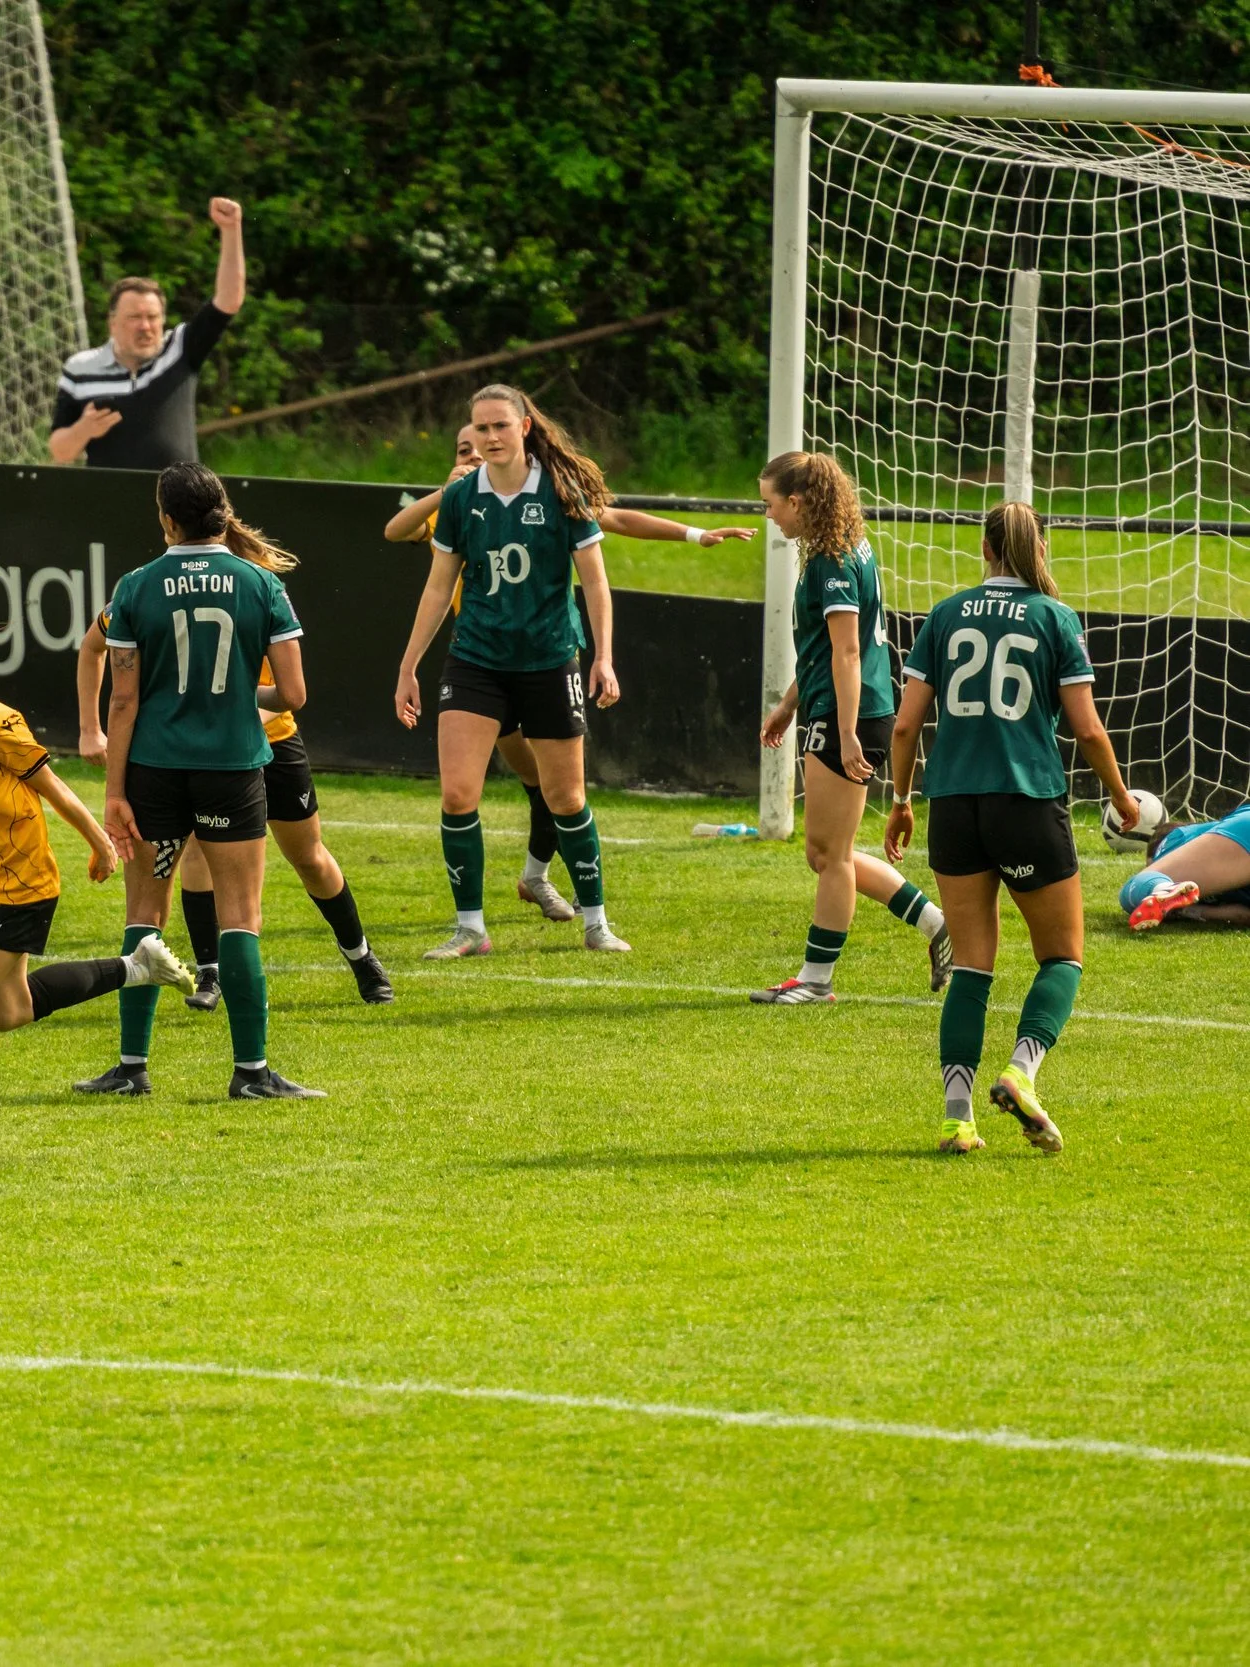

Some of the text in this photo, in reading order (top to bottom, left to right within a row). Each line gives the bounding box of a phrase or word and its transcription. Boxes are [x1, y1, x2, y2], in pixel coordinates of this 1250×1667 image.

[181, 561, 209, 569] BOND
[164, 574, 234, 597] DALTON
[961, 599, 1028, 621] SUTTIE
[172, 607, 234, 695] 17
[946, 628, 1039, 721] 26
[566, 672, 584, 707] 18
